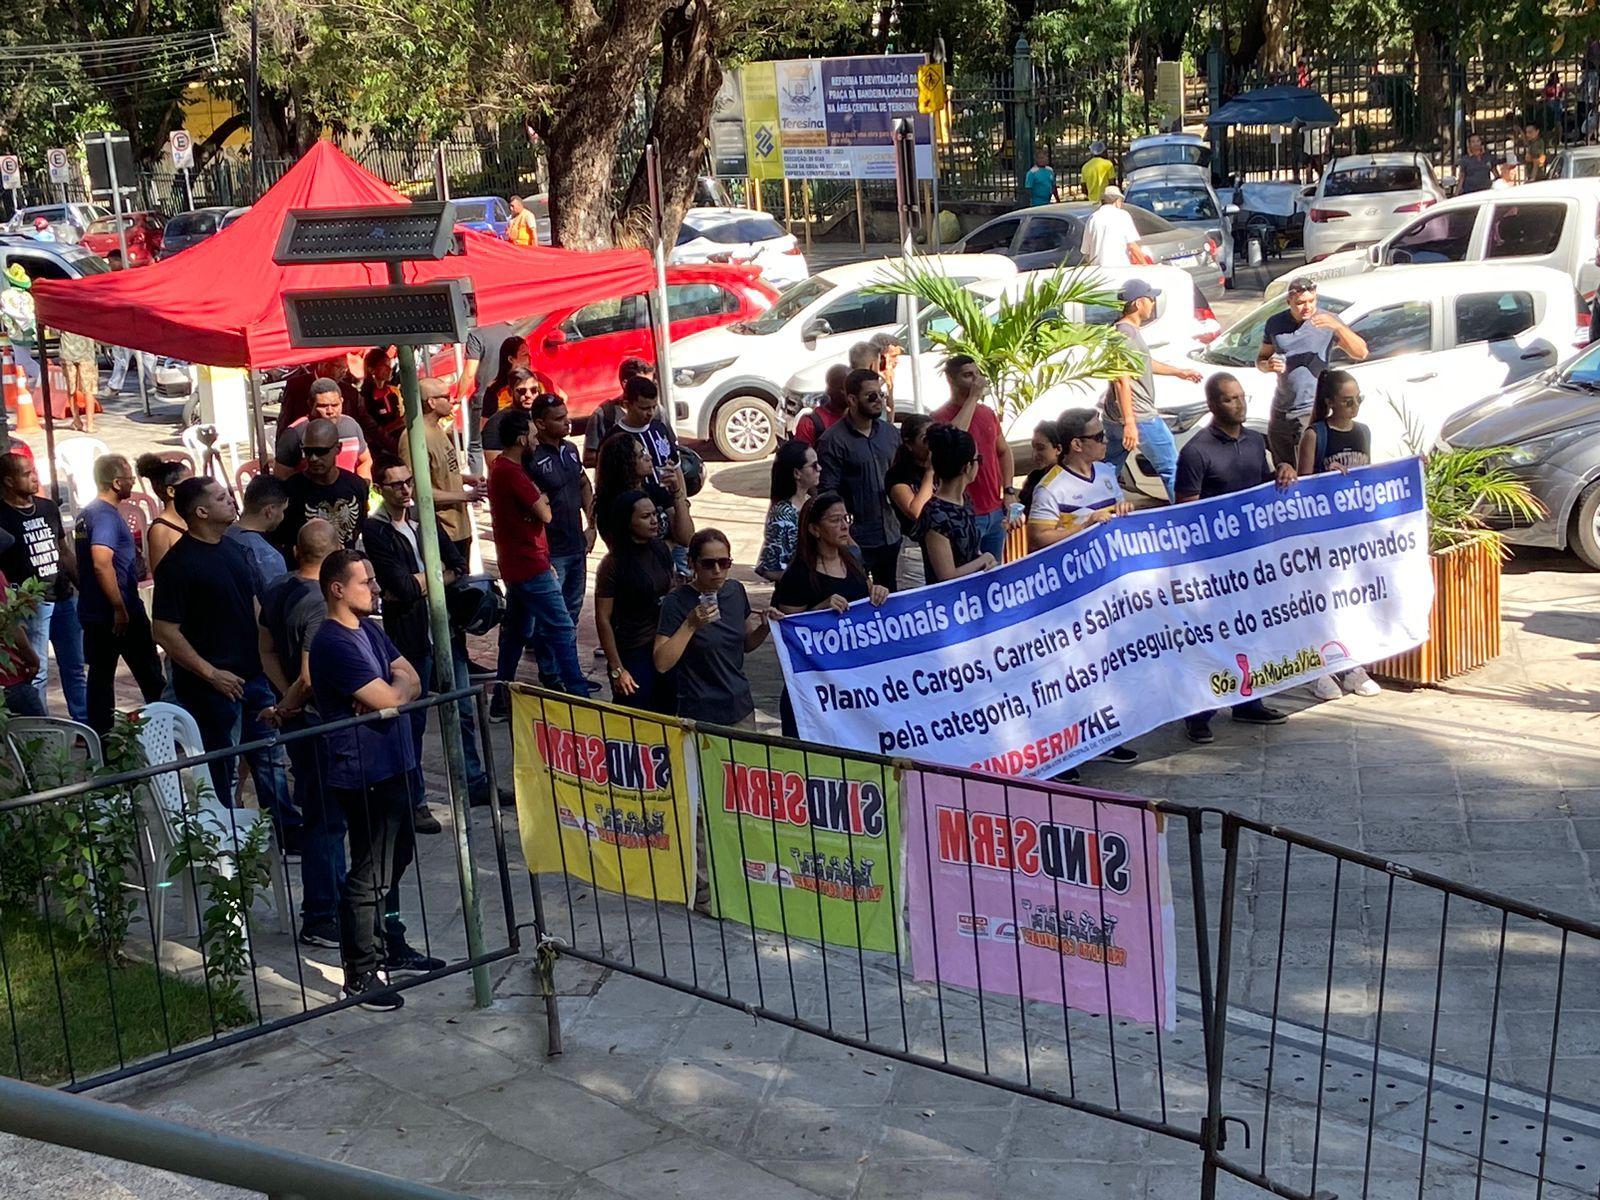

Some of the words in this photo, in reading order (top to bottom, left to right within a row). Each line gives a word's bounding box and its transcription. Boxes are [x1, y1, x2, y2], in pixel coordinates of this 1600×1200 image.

[859, 75, 863, 84] E
[864, 72, 908, 86] REVITALIZAÇÃO
[828, 89, 848, 101] PRAÇA
[879, 102, 888, 112] DE
[782, 117, 824, 129] Teresina
[177, 136, 186, 148] E
[54, 155, 61, 164] E
[6, 161, 13, 171] E
[29, 544, 34, 555] I
[795, 600, 948, 656] Profissionais
[952, 591, 983, 624] da
[986, 562, 1060, 613] Guarda
[1062, 538, 1106, 584] Civil
[1104, 514, 1210, 565] Municipal
[1213, 511, 1240, 541] de
[1241, 493, 1331, 533] Teresina
[1334, 476, 1411, 514] exigem:
[815, 684, 879, 712] Plano
[882, 676, 909, 702] de
[913, 658, 992, 693] Cargos,
[994, 626, 1070, 672] Carreira
[1073, 620, 1083, 642] e
[1085, 588, 1153, 636] Salários
[1158, 591, 1169, 606] e
[1170, 568, 1249, 605] Estatuto
[1254, 560, 1277, 586] da
[1279, 546, 1322, 577] GCM
[1328, 530, 1416, 569] aprovados
[879, 724, 929, 754] pela
[931, 692, 1032, 744] categoria,
[1032, 680, 1061, 709] fim
[1065, 667, 1098, 693] das
[1101, 621, 1214, 682] perseguições
[1218, 622, 1230, 640] e
[1234, 607, 1257, 635] do
[1262, 592, 1327, 628] assédio
[1333, 575, 1387, 608] moral!
